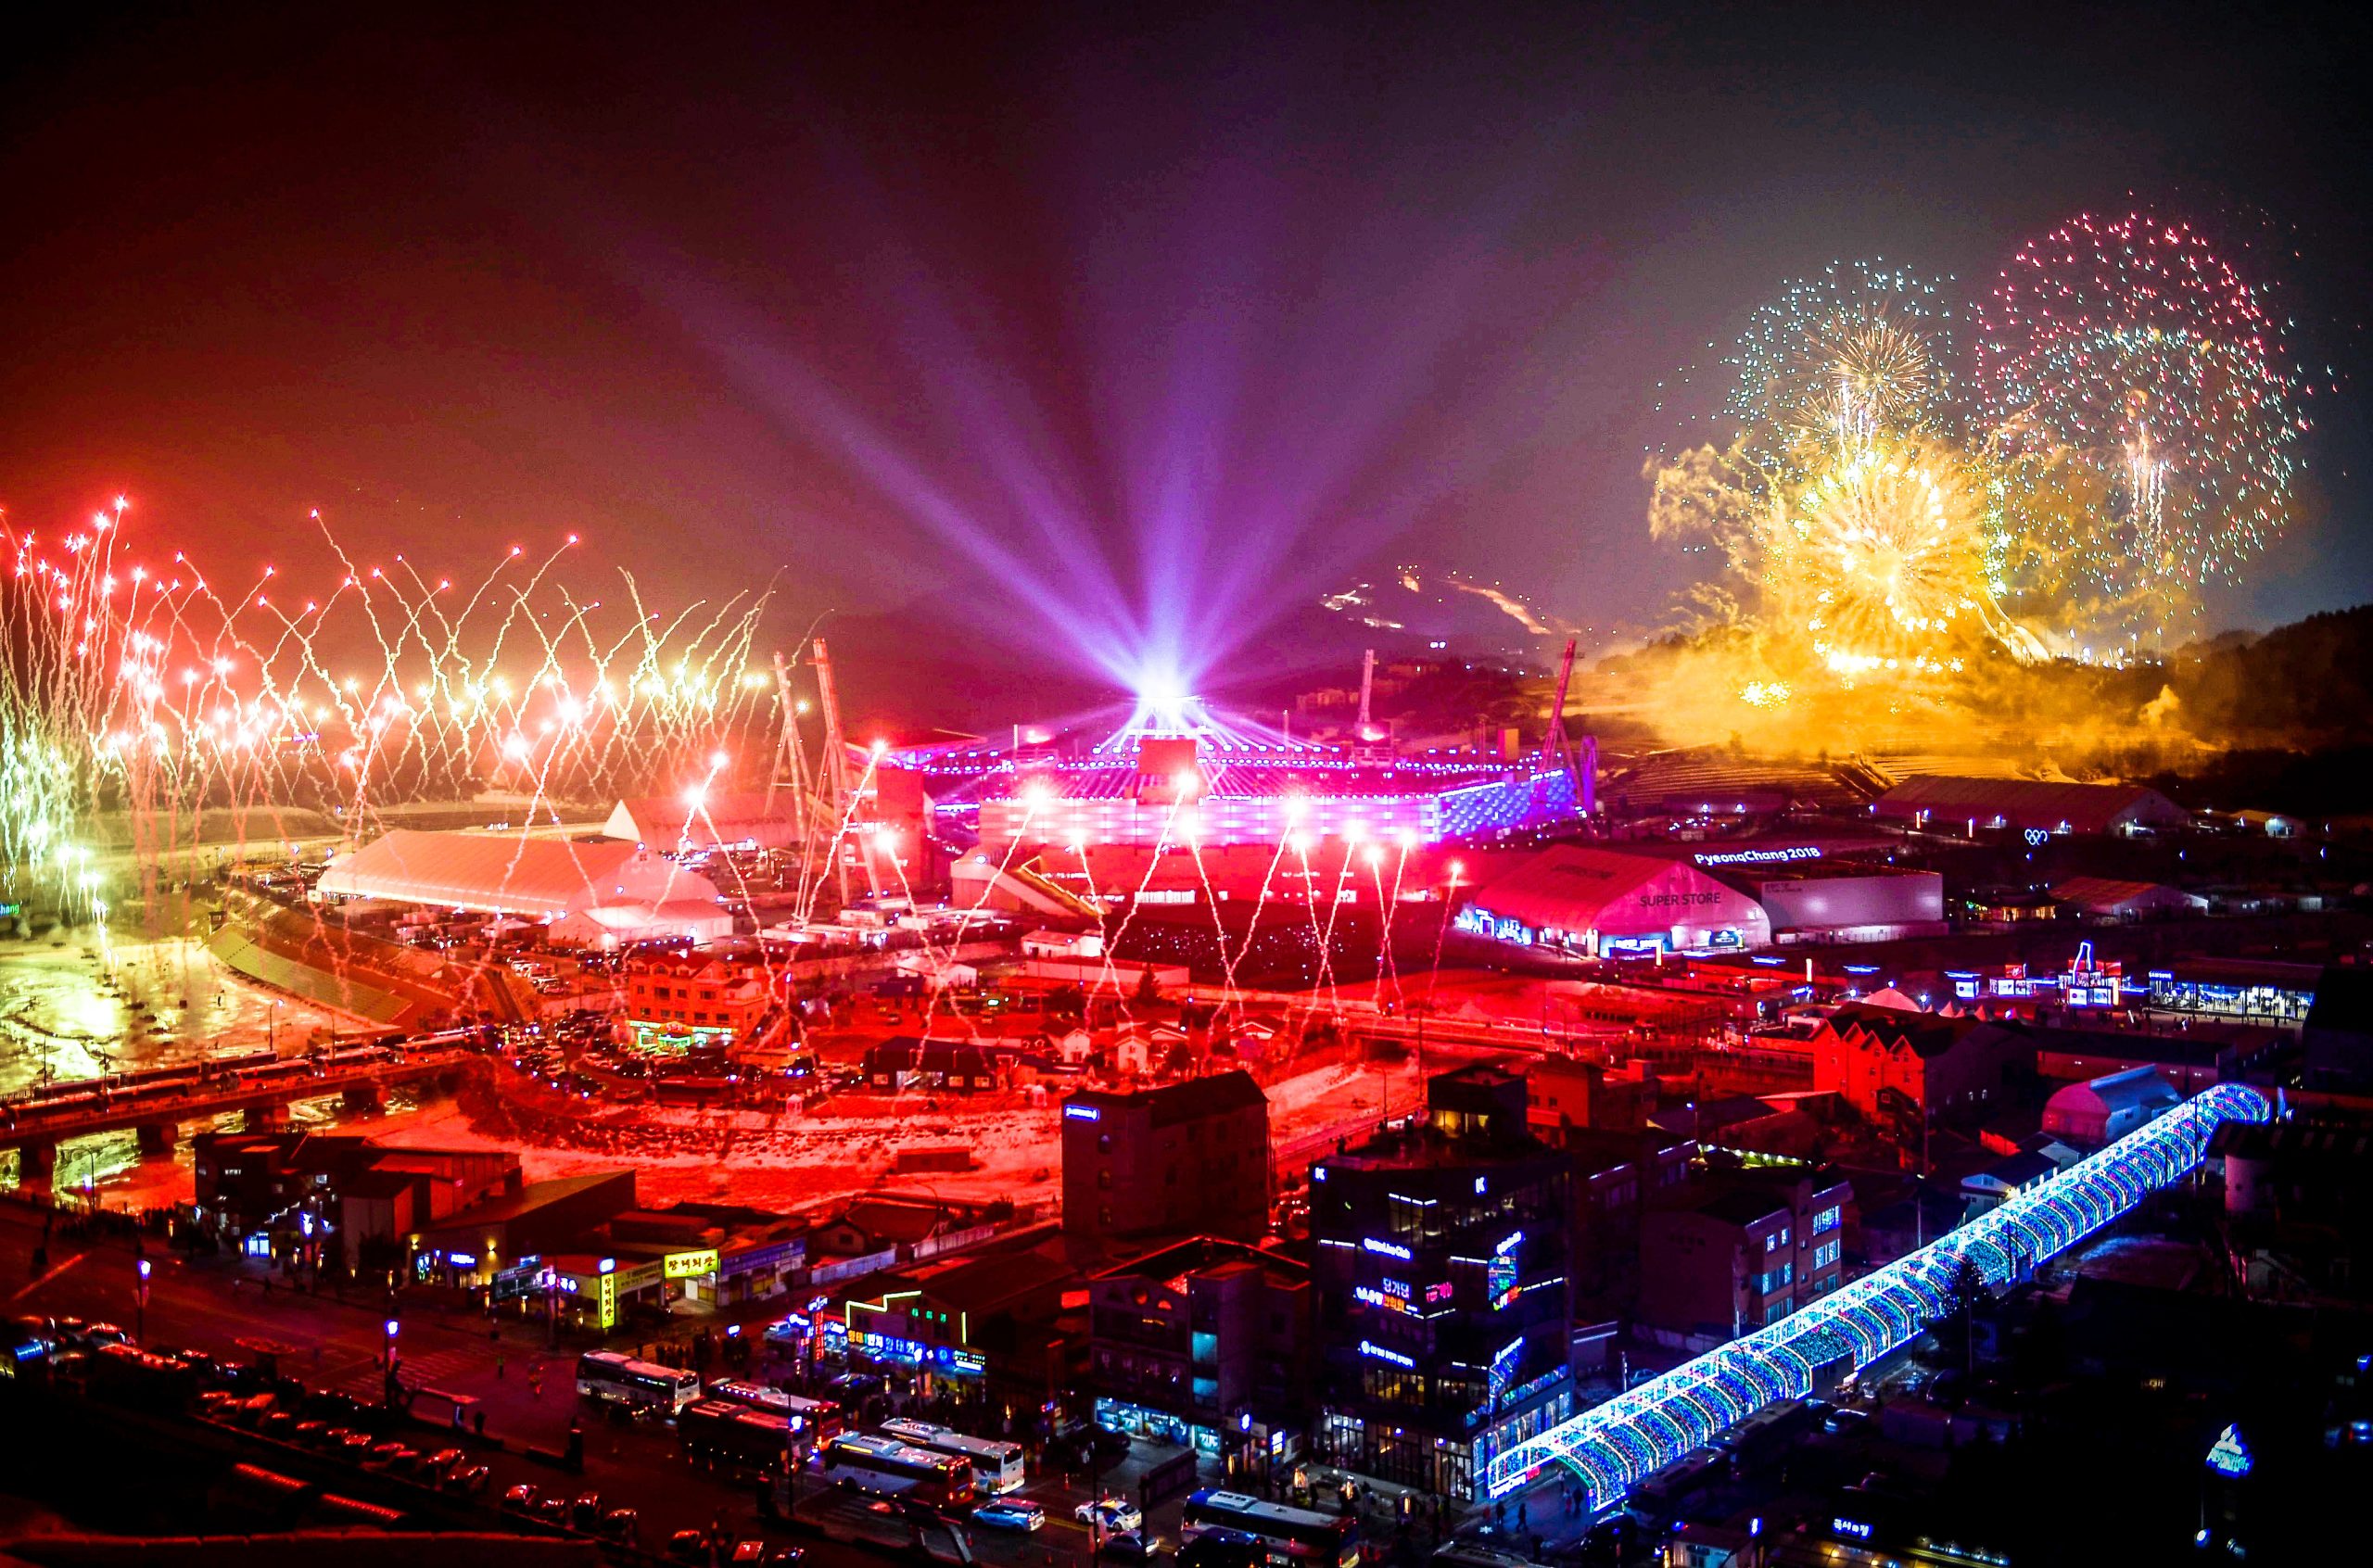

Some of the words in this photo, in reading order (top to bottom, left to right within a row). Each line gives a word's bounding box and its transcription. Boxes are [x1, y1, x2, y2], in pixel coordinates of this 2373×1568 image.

[1694, 850, 1788, 866] PyeongChang
[1786, 847, 1821, 859] 2018
[1640, 894, 1680, 907] SUPER
[1682, 892, 1721, 905] STORE
[1314, 1167, 1325, 1180] K
[1476, 1176, 1487, 1194] K
